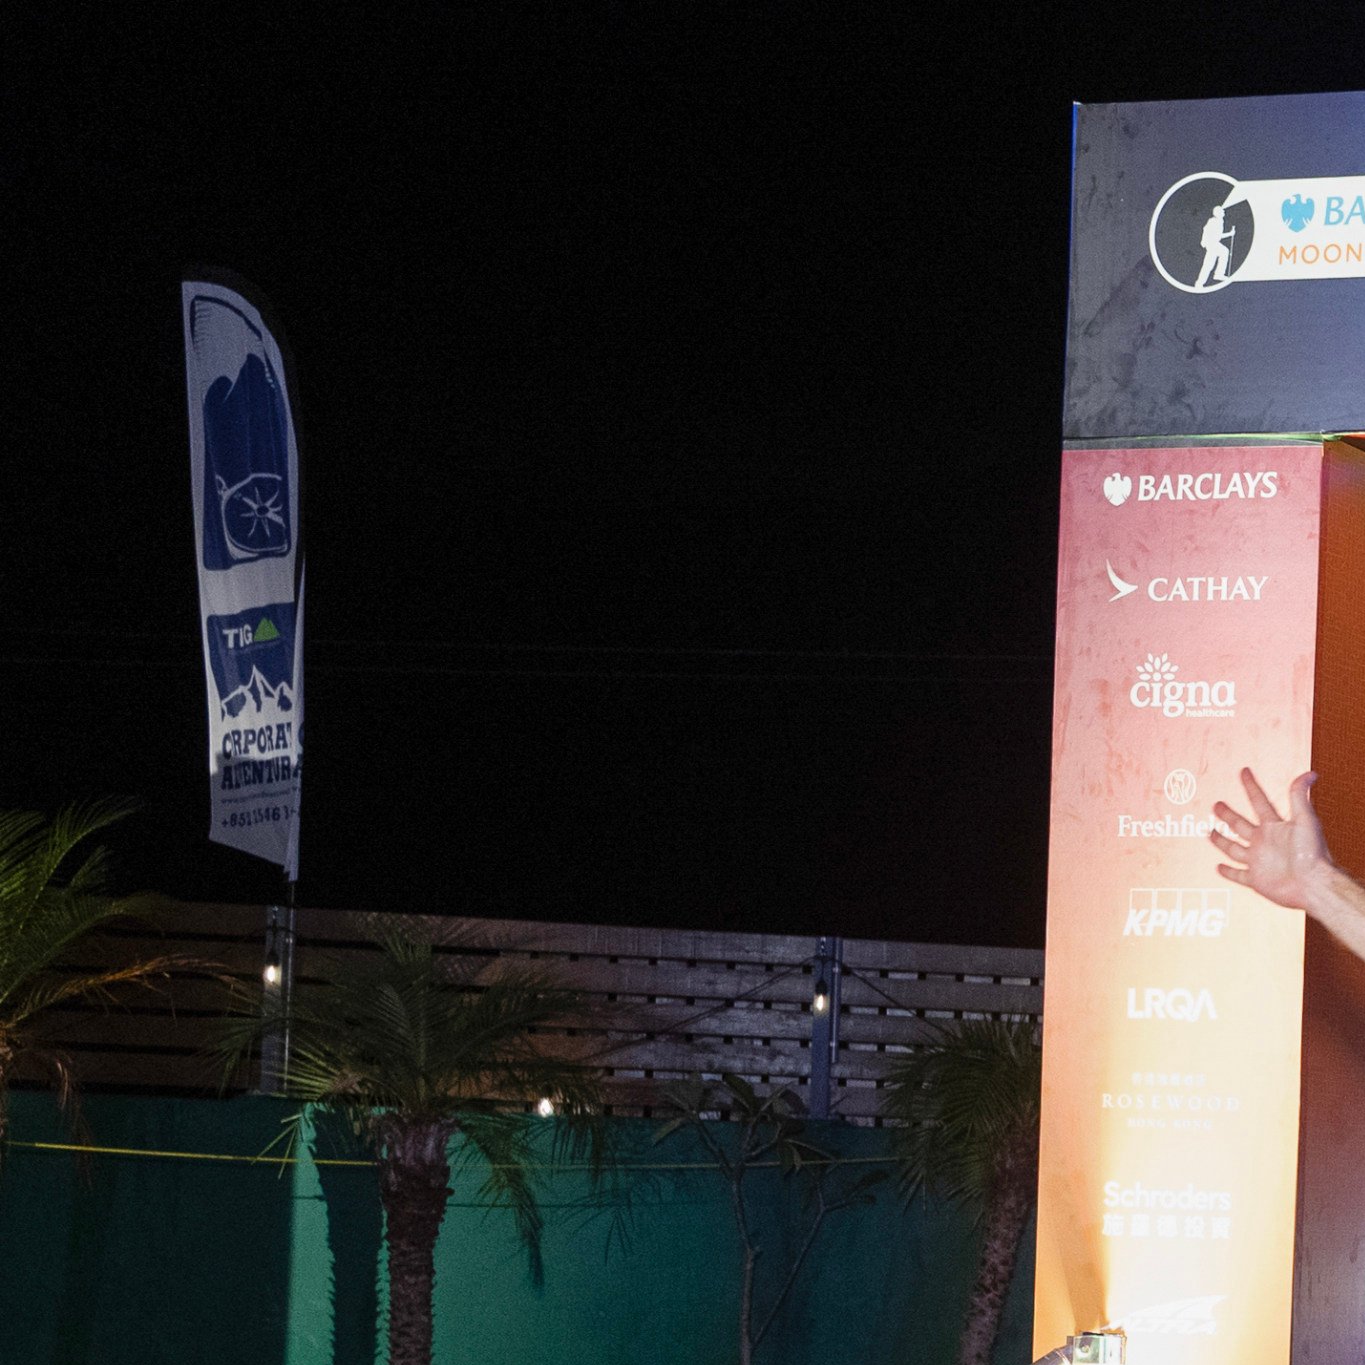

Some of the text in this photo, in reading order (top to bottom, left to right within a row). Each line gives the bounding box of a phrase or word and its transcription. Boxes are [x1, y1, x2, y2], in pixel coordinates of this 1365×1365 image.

[1138, 471, 1278, 501] BARCLAYS
[1147, 575, 1269, 602] CATHAY
[1130, 678, 1237, 718] cigna
[1185, 707, 1236, 718] healthcare
[1117, 814, 1240, 838] Freshfiel
[1123, 908, 1226, 937] KPMG
[1127, 987, 1218, 1022] LRQA
[1103, 1180, 1232, 1211] Schroders
